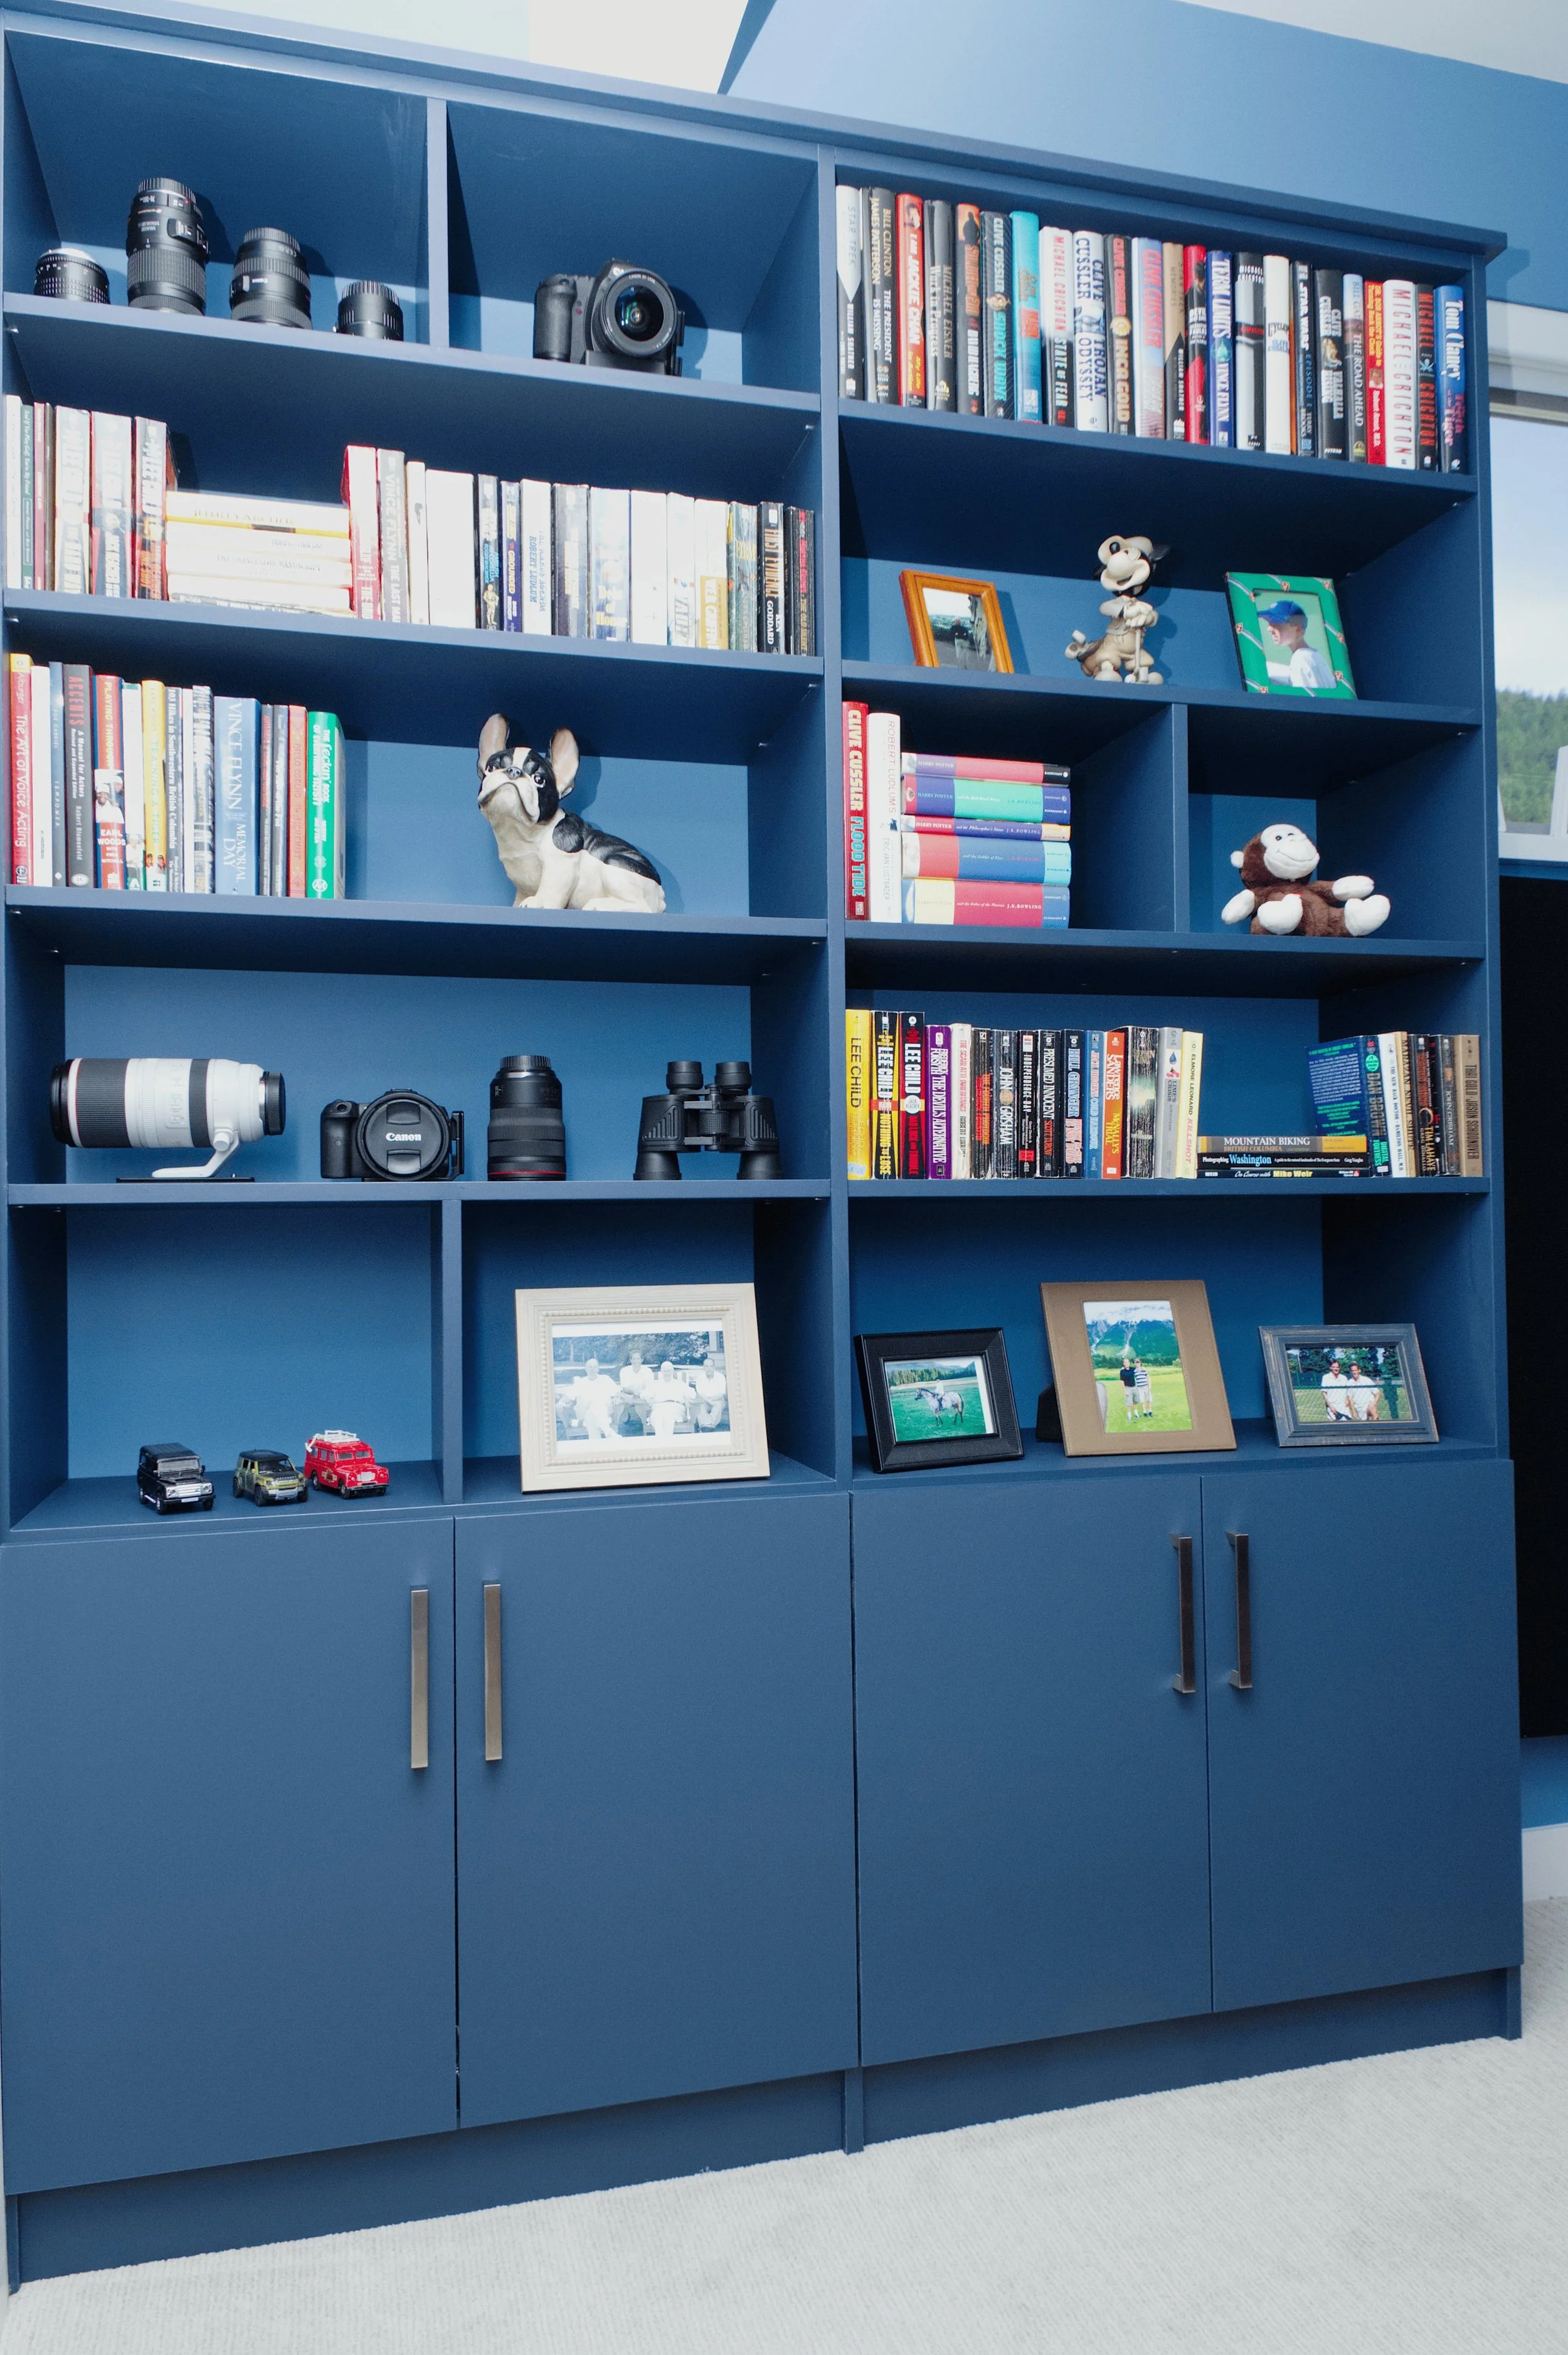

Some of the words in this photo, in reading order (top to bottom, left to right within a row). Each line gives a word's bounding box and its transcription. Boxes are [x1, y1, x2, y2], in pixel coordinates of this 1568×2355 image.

[869, 197, 880, 228] JAMES
[883, 208, 891, 229] BILL
[993, 218, 1004, 246] CLIVE
[871, 229, 881, 285] PATTERSON
[883, 230, 892, 277] CLINTON
[1076, 238, 1091, 299] CUSSLER
[1113, 238, 1125, 268] CLIVE
[994, 247, 1005, 293] CUSSLER
[1092, 259, 1104, 301] CLIVE
[1212, 259, 1231, 296] TERM
[883, 290, 891, 309] THE
[943, 265, 952, 314] MICHAEL
[1115, 268, 1126, 315] CUSSLER
[873, 307, 881, 350] MISSING
[1212, 297, 1232, 339] LIMITS
[1331, 309, 1342, 338] CLIVE
[1392, 289, 1411, 360] MICHAEL
[1418, 293, 1434, 348] MICHAEL
[1444, 299, 1463, 329] Tom
[884, 310, 892, 363] PRESIDENT
[944, 319, 953, 359] EISNER
[993, 312, 1006, 359] SHOCK
[1352, 334, 1362, 355] THE
[1078, 338, 1093, 401] ODYSSEY
[1094, 339, 1106, 398] TROJAN
[1115, 338, 1128, 380] INCA
[1354, 358, 1362, 385] ROAD
[1440, 332, 1464, 381] Clancy
[993, 361, 1006, 401] WAVE
[1216, 362, 1229, 390] VINCE
[1116, 381, 1130, 422] GOLD
[1217, 391, 1229, 422] FLYNN
[1333, 371, 1343, 419] VALHALLA
[1354, 389, 1364, 427] AHEAD
[1393, 373, 1412, 455] CRICHTON
[1419, 383, 1436, 447] CRICHTON
[529, 536, 537, 569] ROBERT
[765, 528, 783, 553] FIRST
[765, 556, 783, 598] EVIDENCE
[16, 672, 25, 704] Alburger
[68, 676, 85, 726] ACCENTS
[167, 689, 176, 702] 103
[16, 715, 28, 736] The
[168, 703, 176, 722] Hikes
[168, 725, 176, 733] in
[228, 703, 242, 752] VINCE
[847, 709, 862, 749] CLIVE
[16, 738, 28, 757] Art
[168, 735, 177, 784] Southwestern
[16, 758, 29, 772] of
[849, 750, 864, 811] CUSSLER
[17, 775, 29, 807] Voice
[169, 786, 177, 811] British
[228, 756, 242, 810] FLYNN
[14, 811, 29, 847] Acting
[169, 812, 177, 849] Columbia
[850, 816, 865, 862] FLOOD
[223, 837, 236, 869] DAY
[235, 824, 246, 883] MEMORIAL
[851, 864, 866, 897] TIDE
[850, 1038, 861, 1063] LEE
[877, 1046, 893, 1067] LEE
[904, 1043, 921, 1063] LEE
[931, 1048, 941, 1075] FORSYTH
[1043, 1048, 1054, 1083] PRESUMED
[1068, 1048, 1080, 1071] BILL
[850, 1066, 862, 1108] CHILD
[877, 1068, 894, 1099] CHILD
[904, 1064, 921, 1093] CHILD
[933, 1076, 946, 1091] THE
[1000, 1066, 1013, 1090] JOHN
[1023, 1055, 1032, 1098] INDEPENDENCE
[1106, 1053, 1115, 1100] SANDERS
[1114, 1055, 1123, 1100] Lawrence
[1367, 1072, 1382, 1094] DAN
[1465, 1065, 1478, 1079] THAI
[1466, 1080, 1478, 1095] GOLD
[932, 1092, 946, 1117] DEVIL'S
[1023, 1101, 1032, 1112] DAY
[1043, 1085, 1054, 1120] INNOCENT
[1068, 1071, 1080, 1117] GRANGER
[1466, 1099, 1478, 1119] JASON
[879, 1113, 891, 1147] NOTHING
[1000, 1105, 1013, 1145] GRISHAM
[1044, 1120, 1052, 1137] SCOTT
[1370, 1097, 1387, 1136] BROWN
[385, 1132, 422, 1142] Canon
[933, 1118, 946, 1163] ALTERNATIVE
[1279, 1137, 1310, 1146] BIKING
[1425, 1126, 1433, 1142] TIM
[1466, 1120, 1479, 1159] SCHOONOVER
[879, 1156, 891, 1175] LOSE
[1229, 1154, 1271, 1167] Washington
[1373, 1140, 1382, 1166] FORTRESS
[1380, 1141, 1389, 1162] DIGITAL
[1426, 1143, 1436, 1171] LAHAYE
